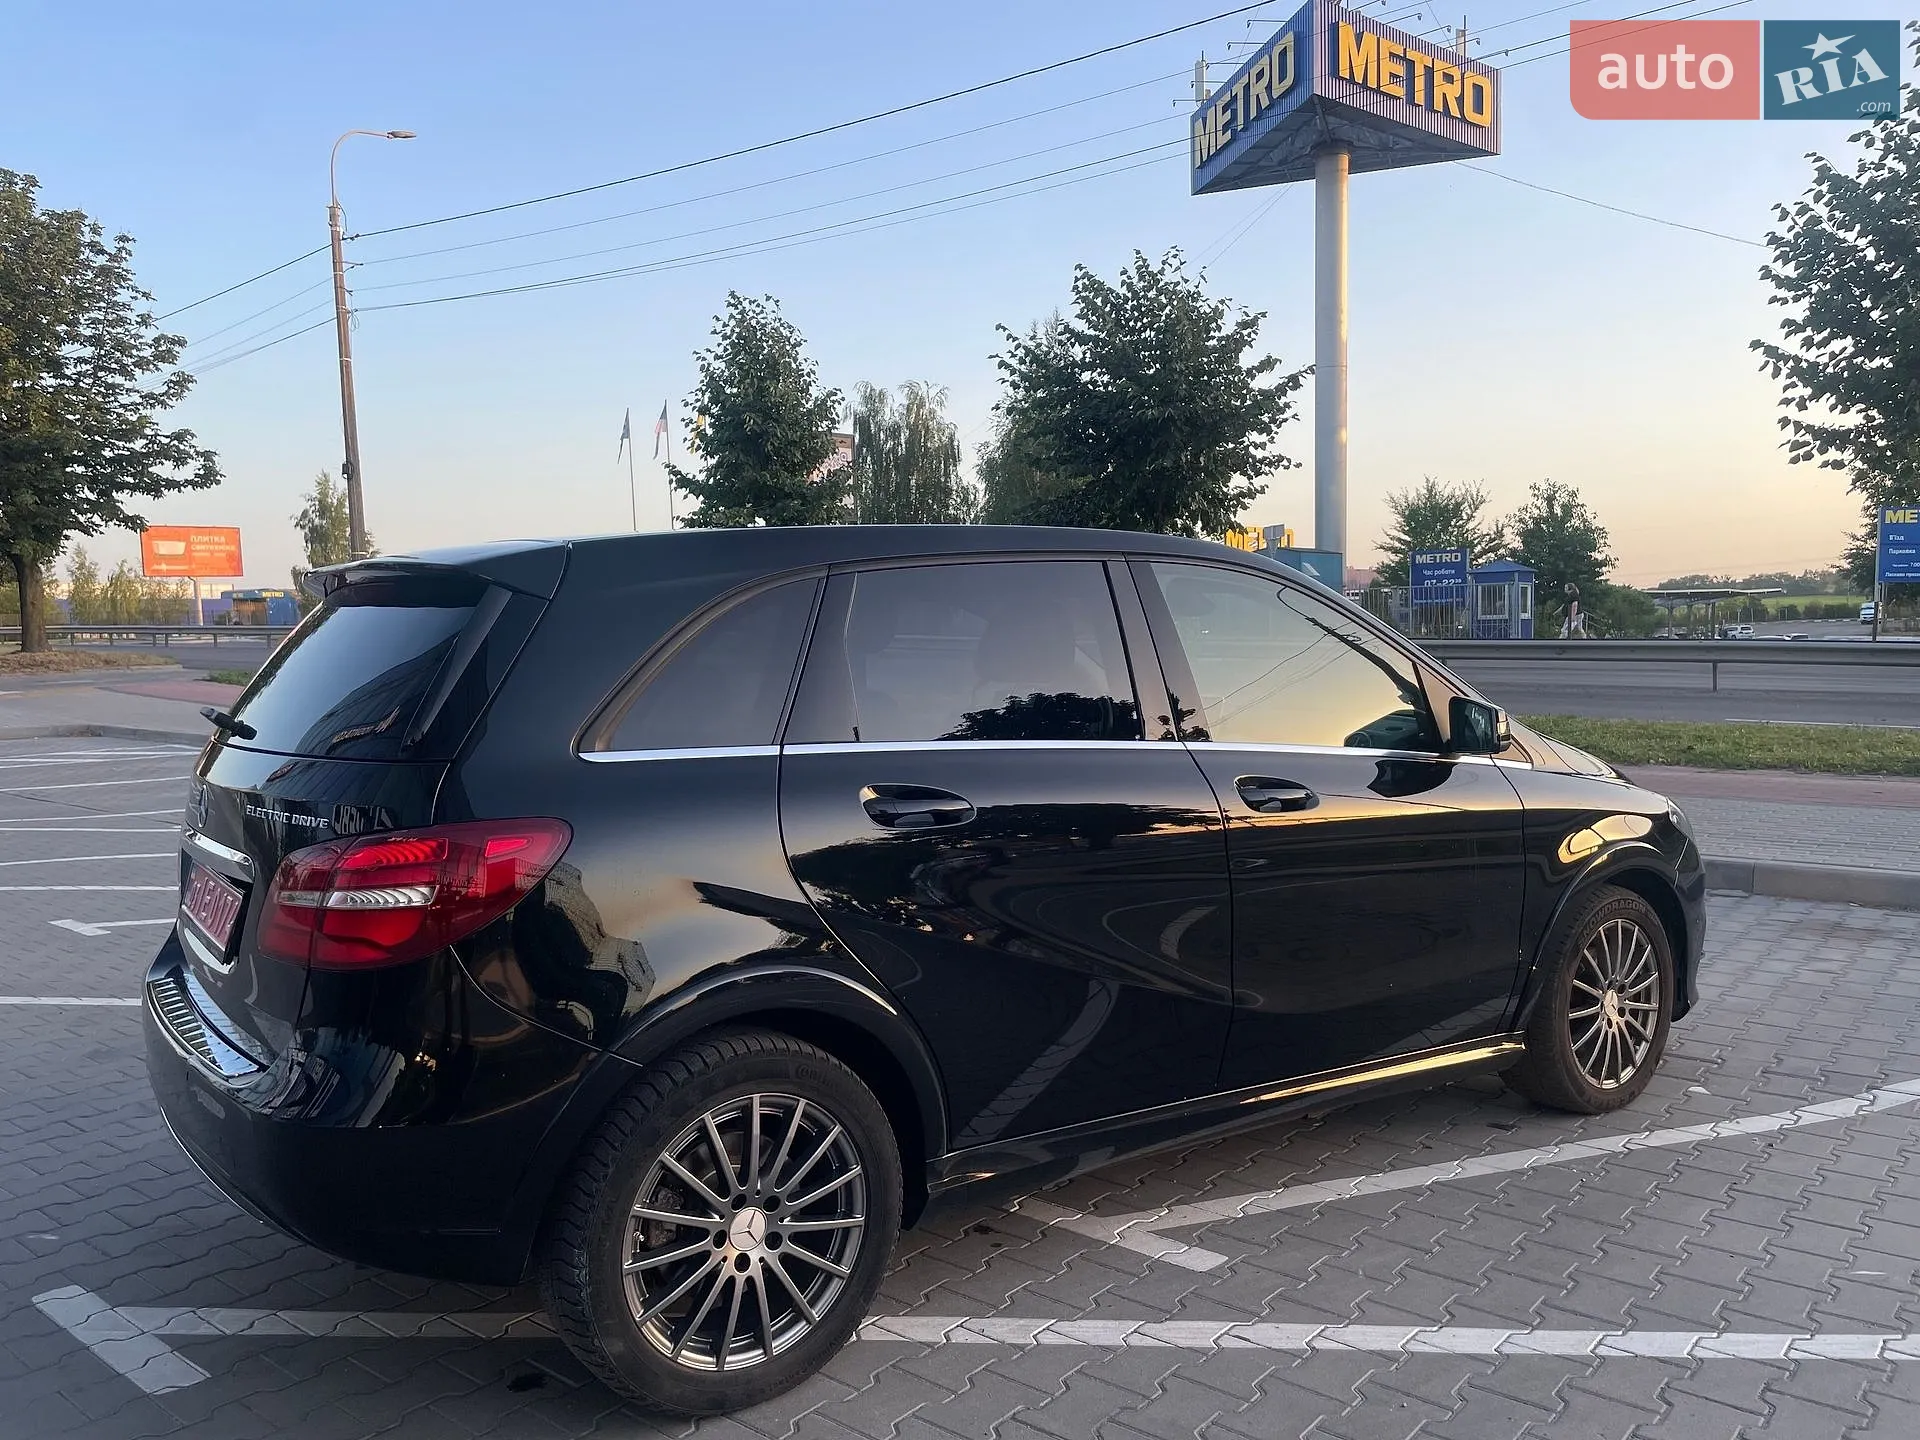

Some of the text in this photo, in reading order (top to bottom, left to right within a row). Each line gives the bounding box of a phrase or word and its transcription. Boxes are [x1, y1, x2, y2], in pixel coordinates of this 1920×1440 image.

[1338, 21, 1492, 128] METRO
[1194, 31, 1295, 169] METRO
[1885, 509, 1920, 524] ME
[1416, 552, 1461, 564] METRO
[246, 804, 330, 829] ELECTRIC DRIVE
